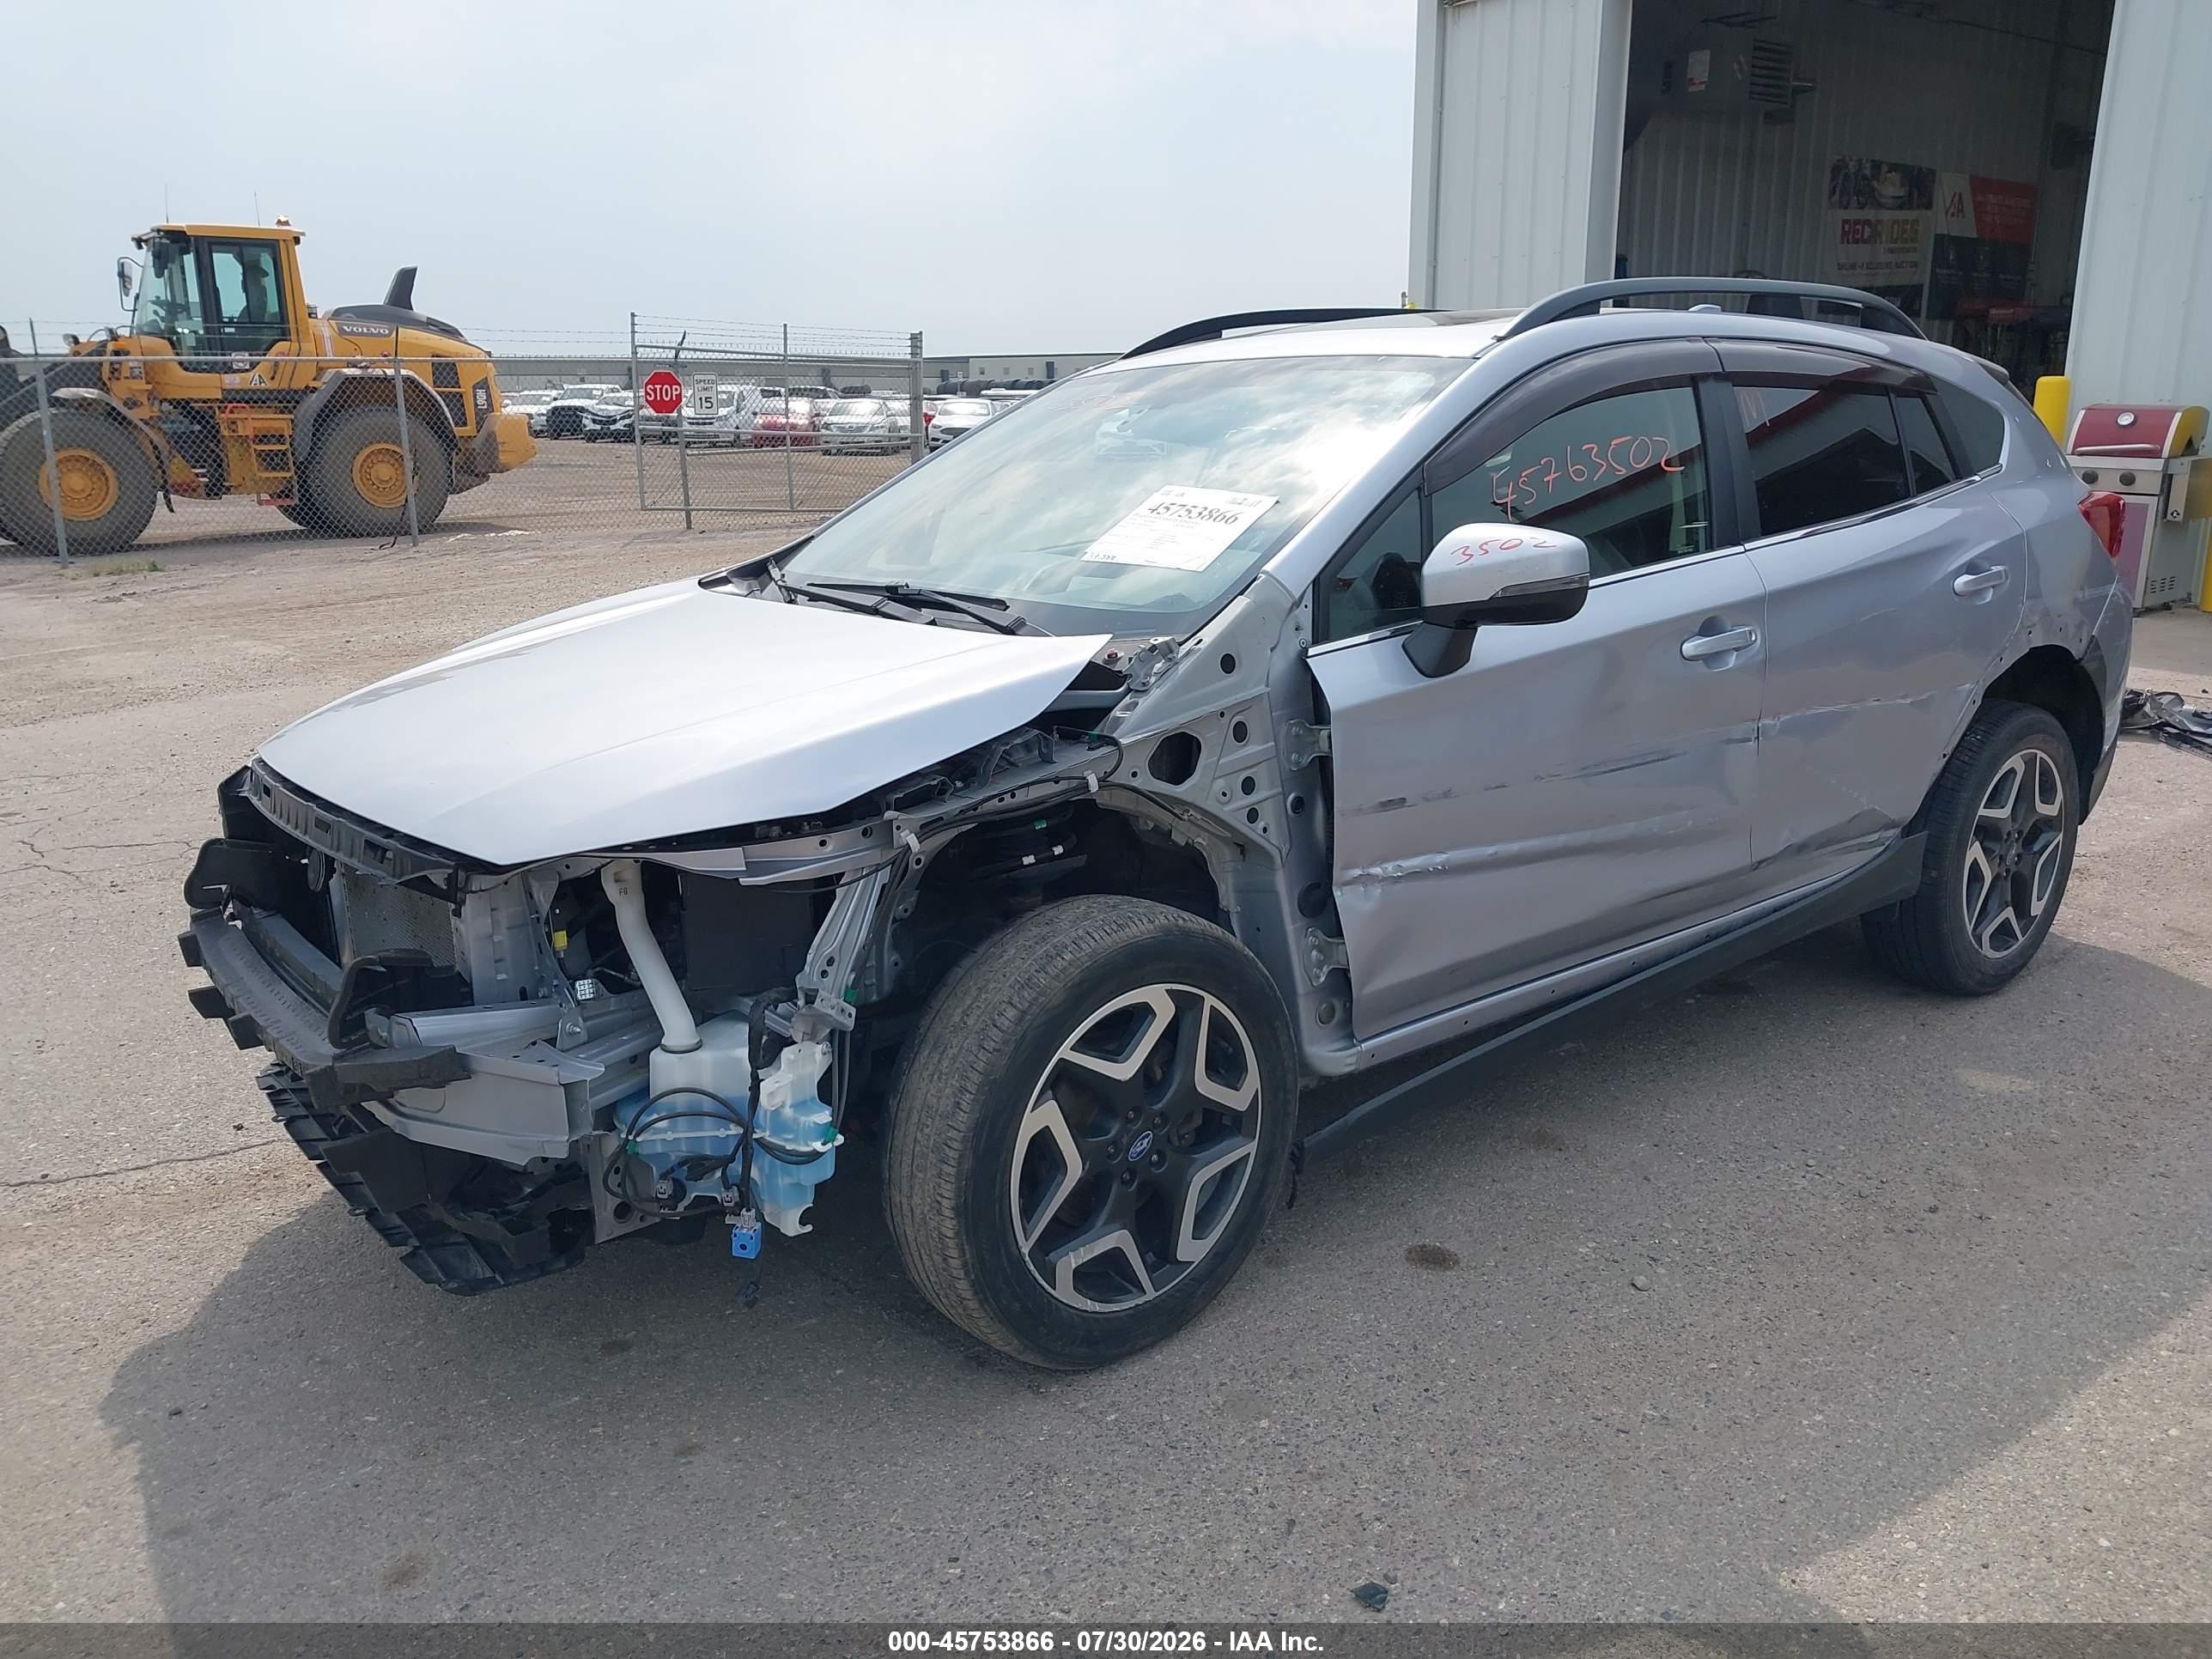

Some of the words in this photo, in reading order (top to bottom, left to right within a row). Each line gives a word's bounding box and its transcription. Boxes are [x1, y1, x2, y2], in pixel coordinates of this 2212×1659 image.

[342, 325, 389, 334] VOLVO
[476, 389, 488, 409] L90H
[647, 385, 680, 401] STOP
[698, 397, 714, 410] 15
[1492, 436, 1685, 522] 45763502
[1147, 501, 1244, 526] 45753866
[1450, 536, 1558, 567] 3502
